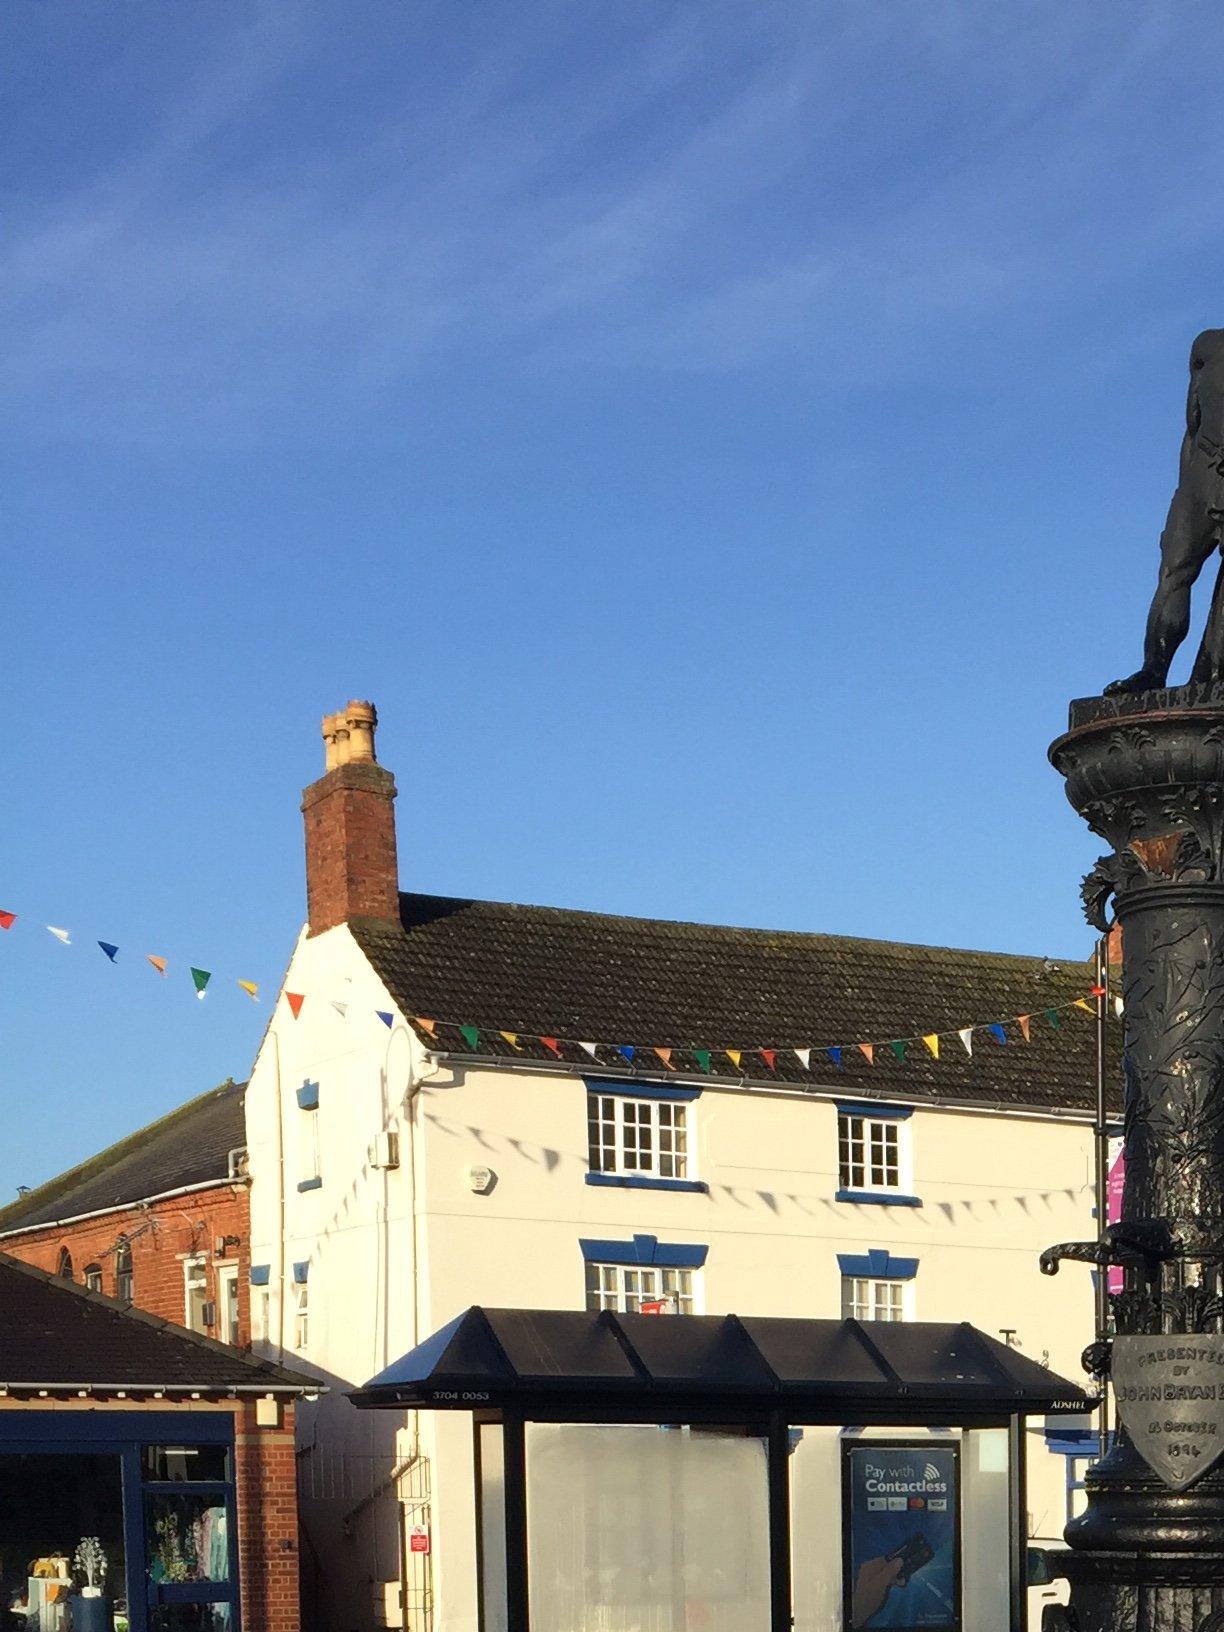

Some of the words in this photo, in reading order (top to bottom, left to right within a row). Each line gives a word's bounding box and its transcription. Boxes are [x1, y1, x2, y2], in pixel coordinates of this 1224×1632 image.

[1173, 1365, 1190, 1376] BY
[433, 1391, 458, 1400] 3704
[1117, 1385, 1161, 1402] JOHN
[865, 1464, 886, 1480] Pay
[888, 1465, 914, 1478] with
[865, 1479, 947, 1492] Contactless
